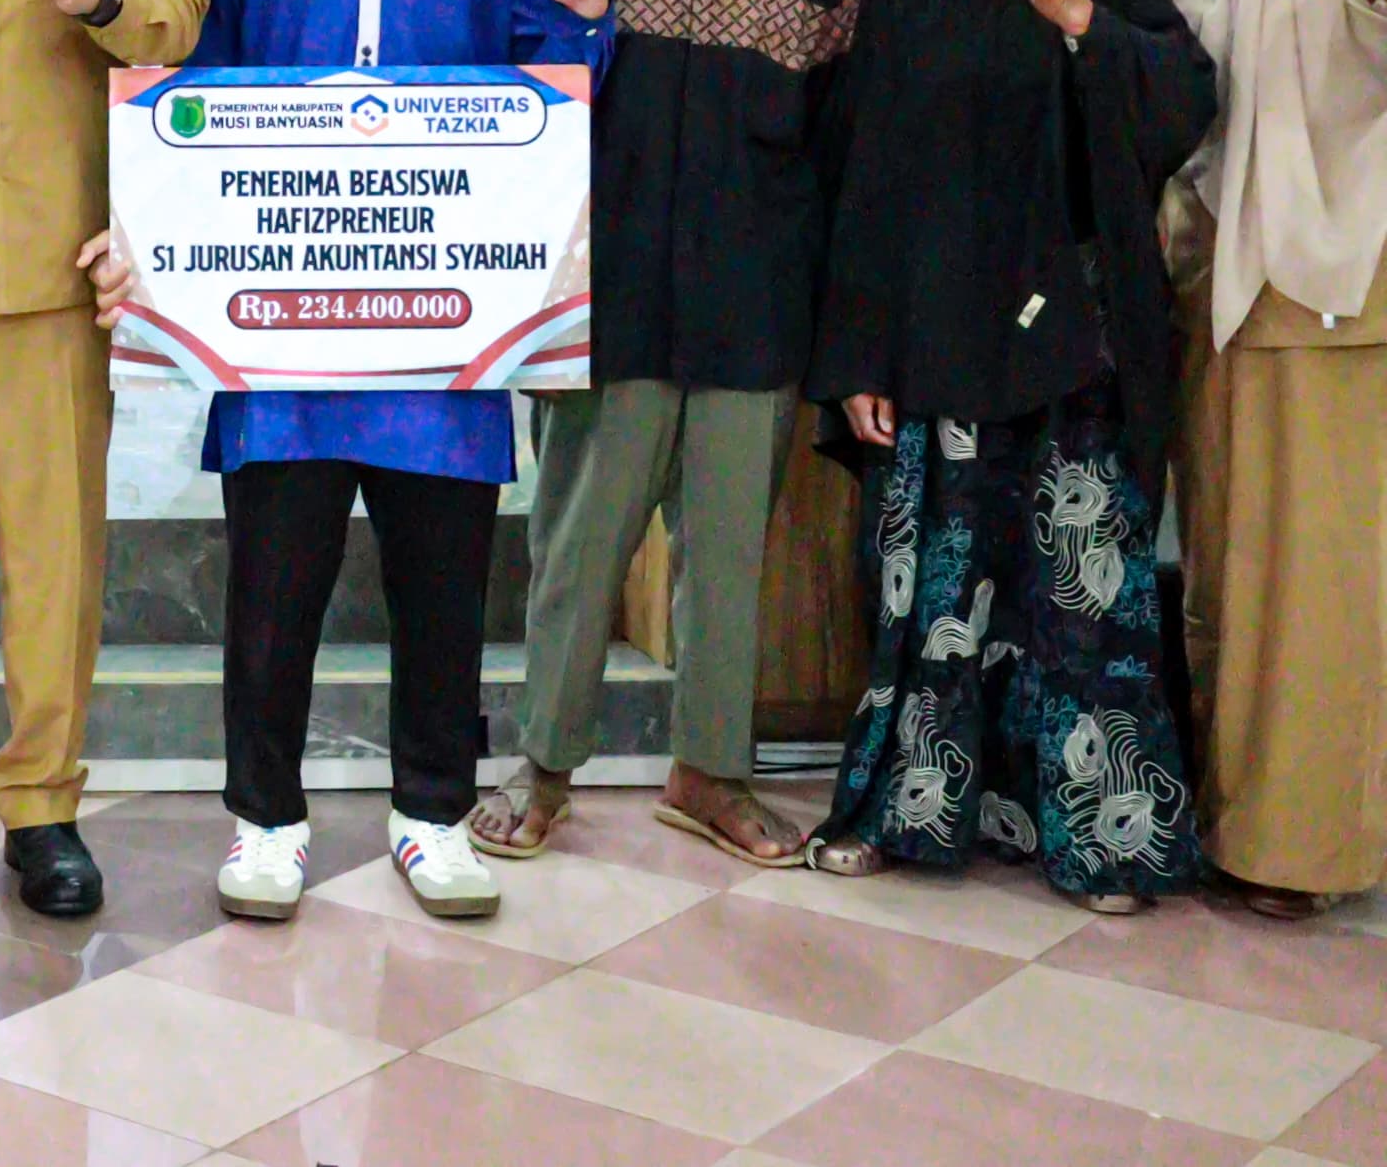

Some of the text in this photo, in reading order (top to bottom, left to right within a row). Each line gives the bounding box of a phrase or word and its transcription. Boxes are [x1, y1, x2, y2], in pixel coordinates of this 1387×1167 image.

[210, 103, 343, 113] PEMERINTAH KABUPATEN
[395, 97, 529, 114] UNIVERSITAS
[210, 115, 343, 129] MUSI BANYUASIN
[425, 117, 499, 133] TAZKIA
[221, 169, 470, 197] PENERIMA BEASISWA
[257, 207, 434, 234] HAFIZPRENEUR
[153, 243, 547, 272] S1 JURUSAN AKUNTANSI SYARIAH
[238, 295, 462, 326] Rp. 234.400.000
